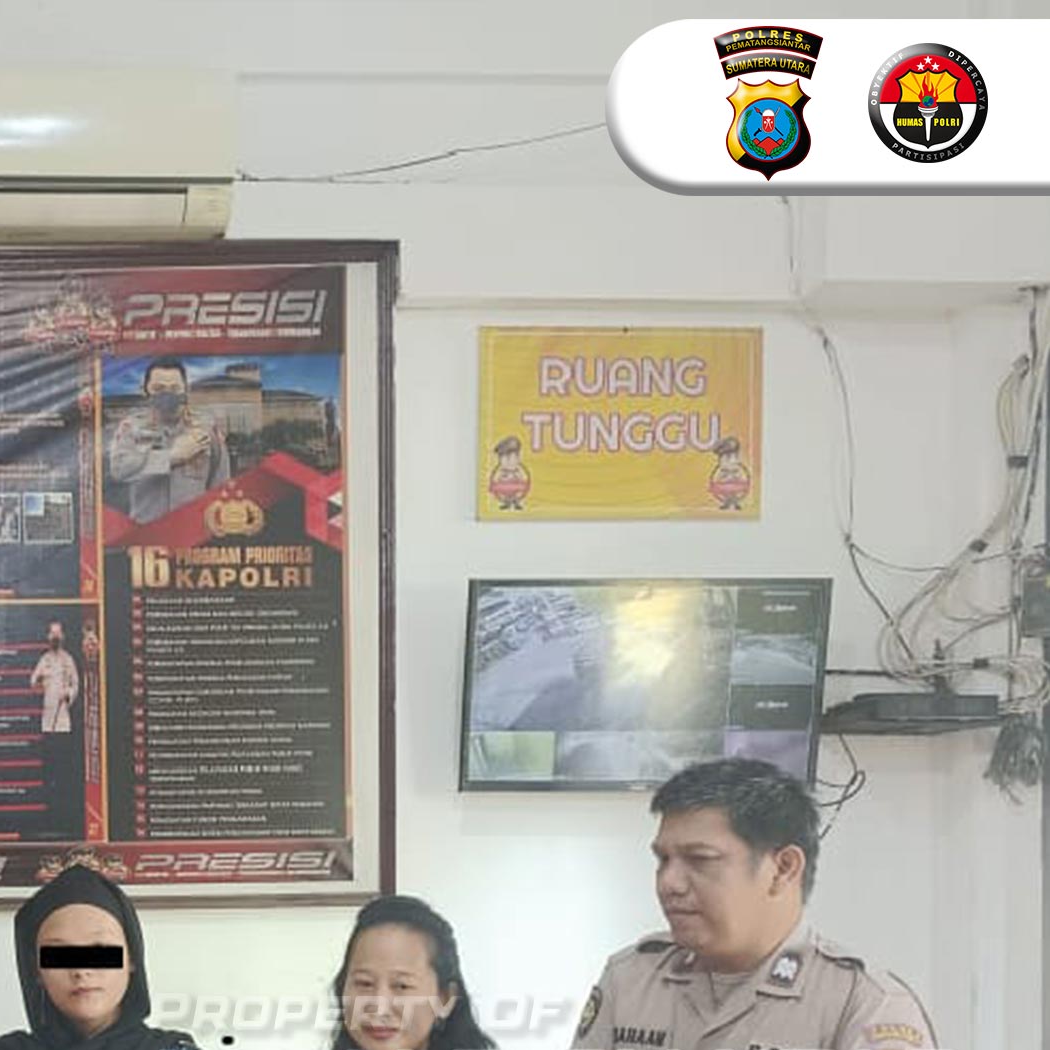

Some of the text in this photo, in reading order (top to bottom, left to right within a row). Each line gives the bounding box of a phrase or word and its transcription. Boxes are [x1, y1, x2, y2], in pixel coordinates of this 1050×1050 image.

[124, 290, 327, 326] PRESISI
[538, 356, 707, 396] RUANG
[521, 411, 721, 452] TUNGGU
[128, 545, 170, 588] 16
[176, 545, 242, 565] PROGRAM
[175, 567, 313, 588] KAPOLRI
[135, 851, 336, 871] PRESISI
